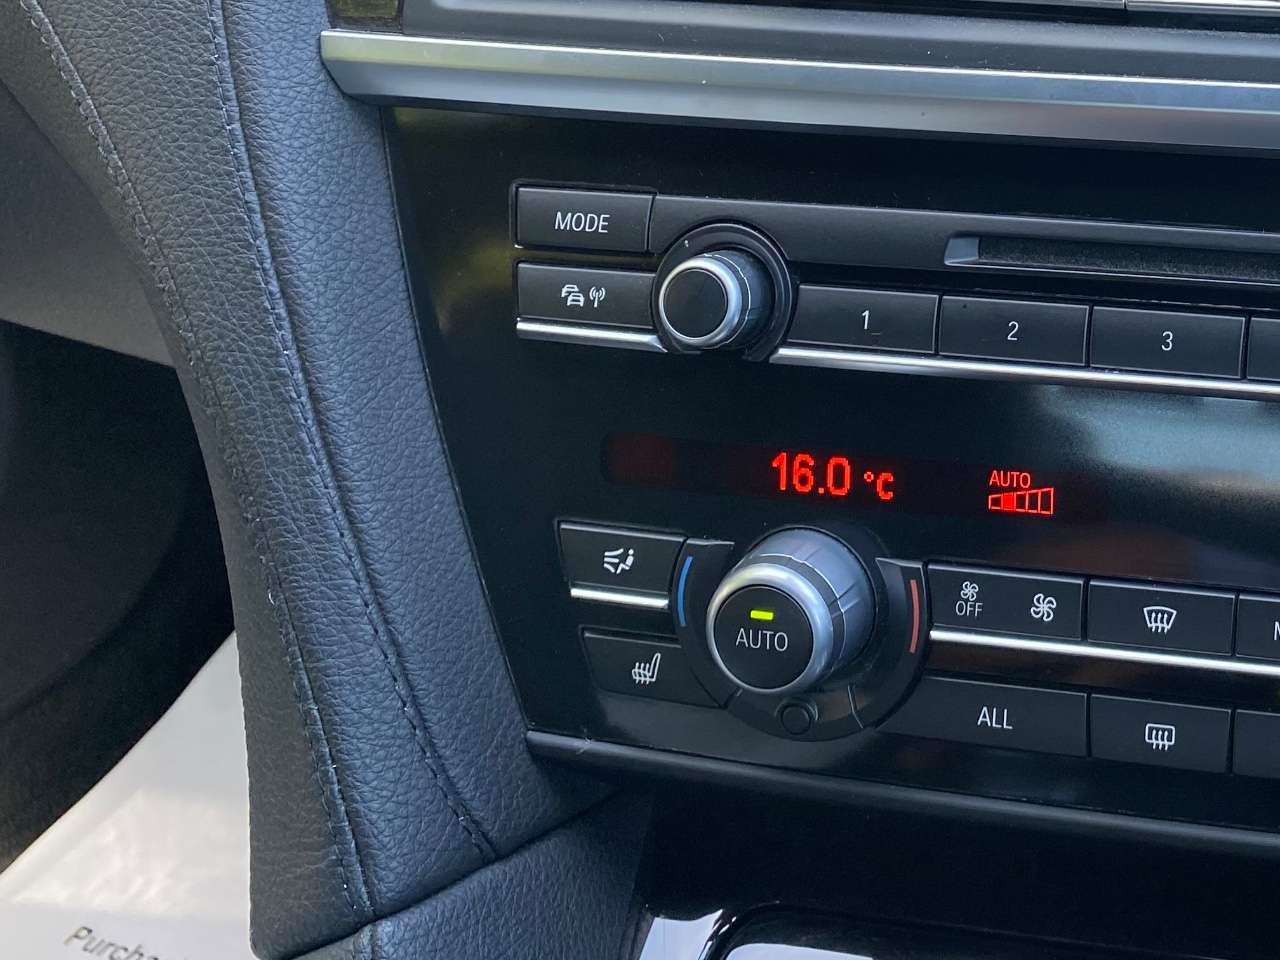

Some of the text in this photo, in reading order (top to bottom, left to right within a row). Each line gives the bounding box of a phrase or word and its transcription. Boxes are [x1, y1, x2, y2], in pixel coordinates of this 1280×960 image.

[554, 211, 611, 233] MODE
[861, 310, 871, 330] 1
[1006, 321, 1019, 341] 2
[1161, 331, 1174, 352] 3
[770, 451, 851, 497] 16.0
[989, 470, 1032, 489] AUTO
[955, 600, 984, 618] OFF
[735, 627, 789, 653] AUTO
[977, 706, 1014, 730] ALL
